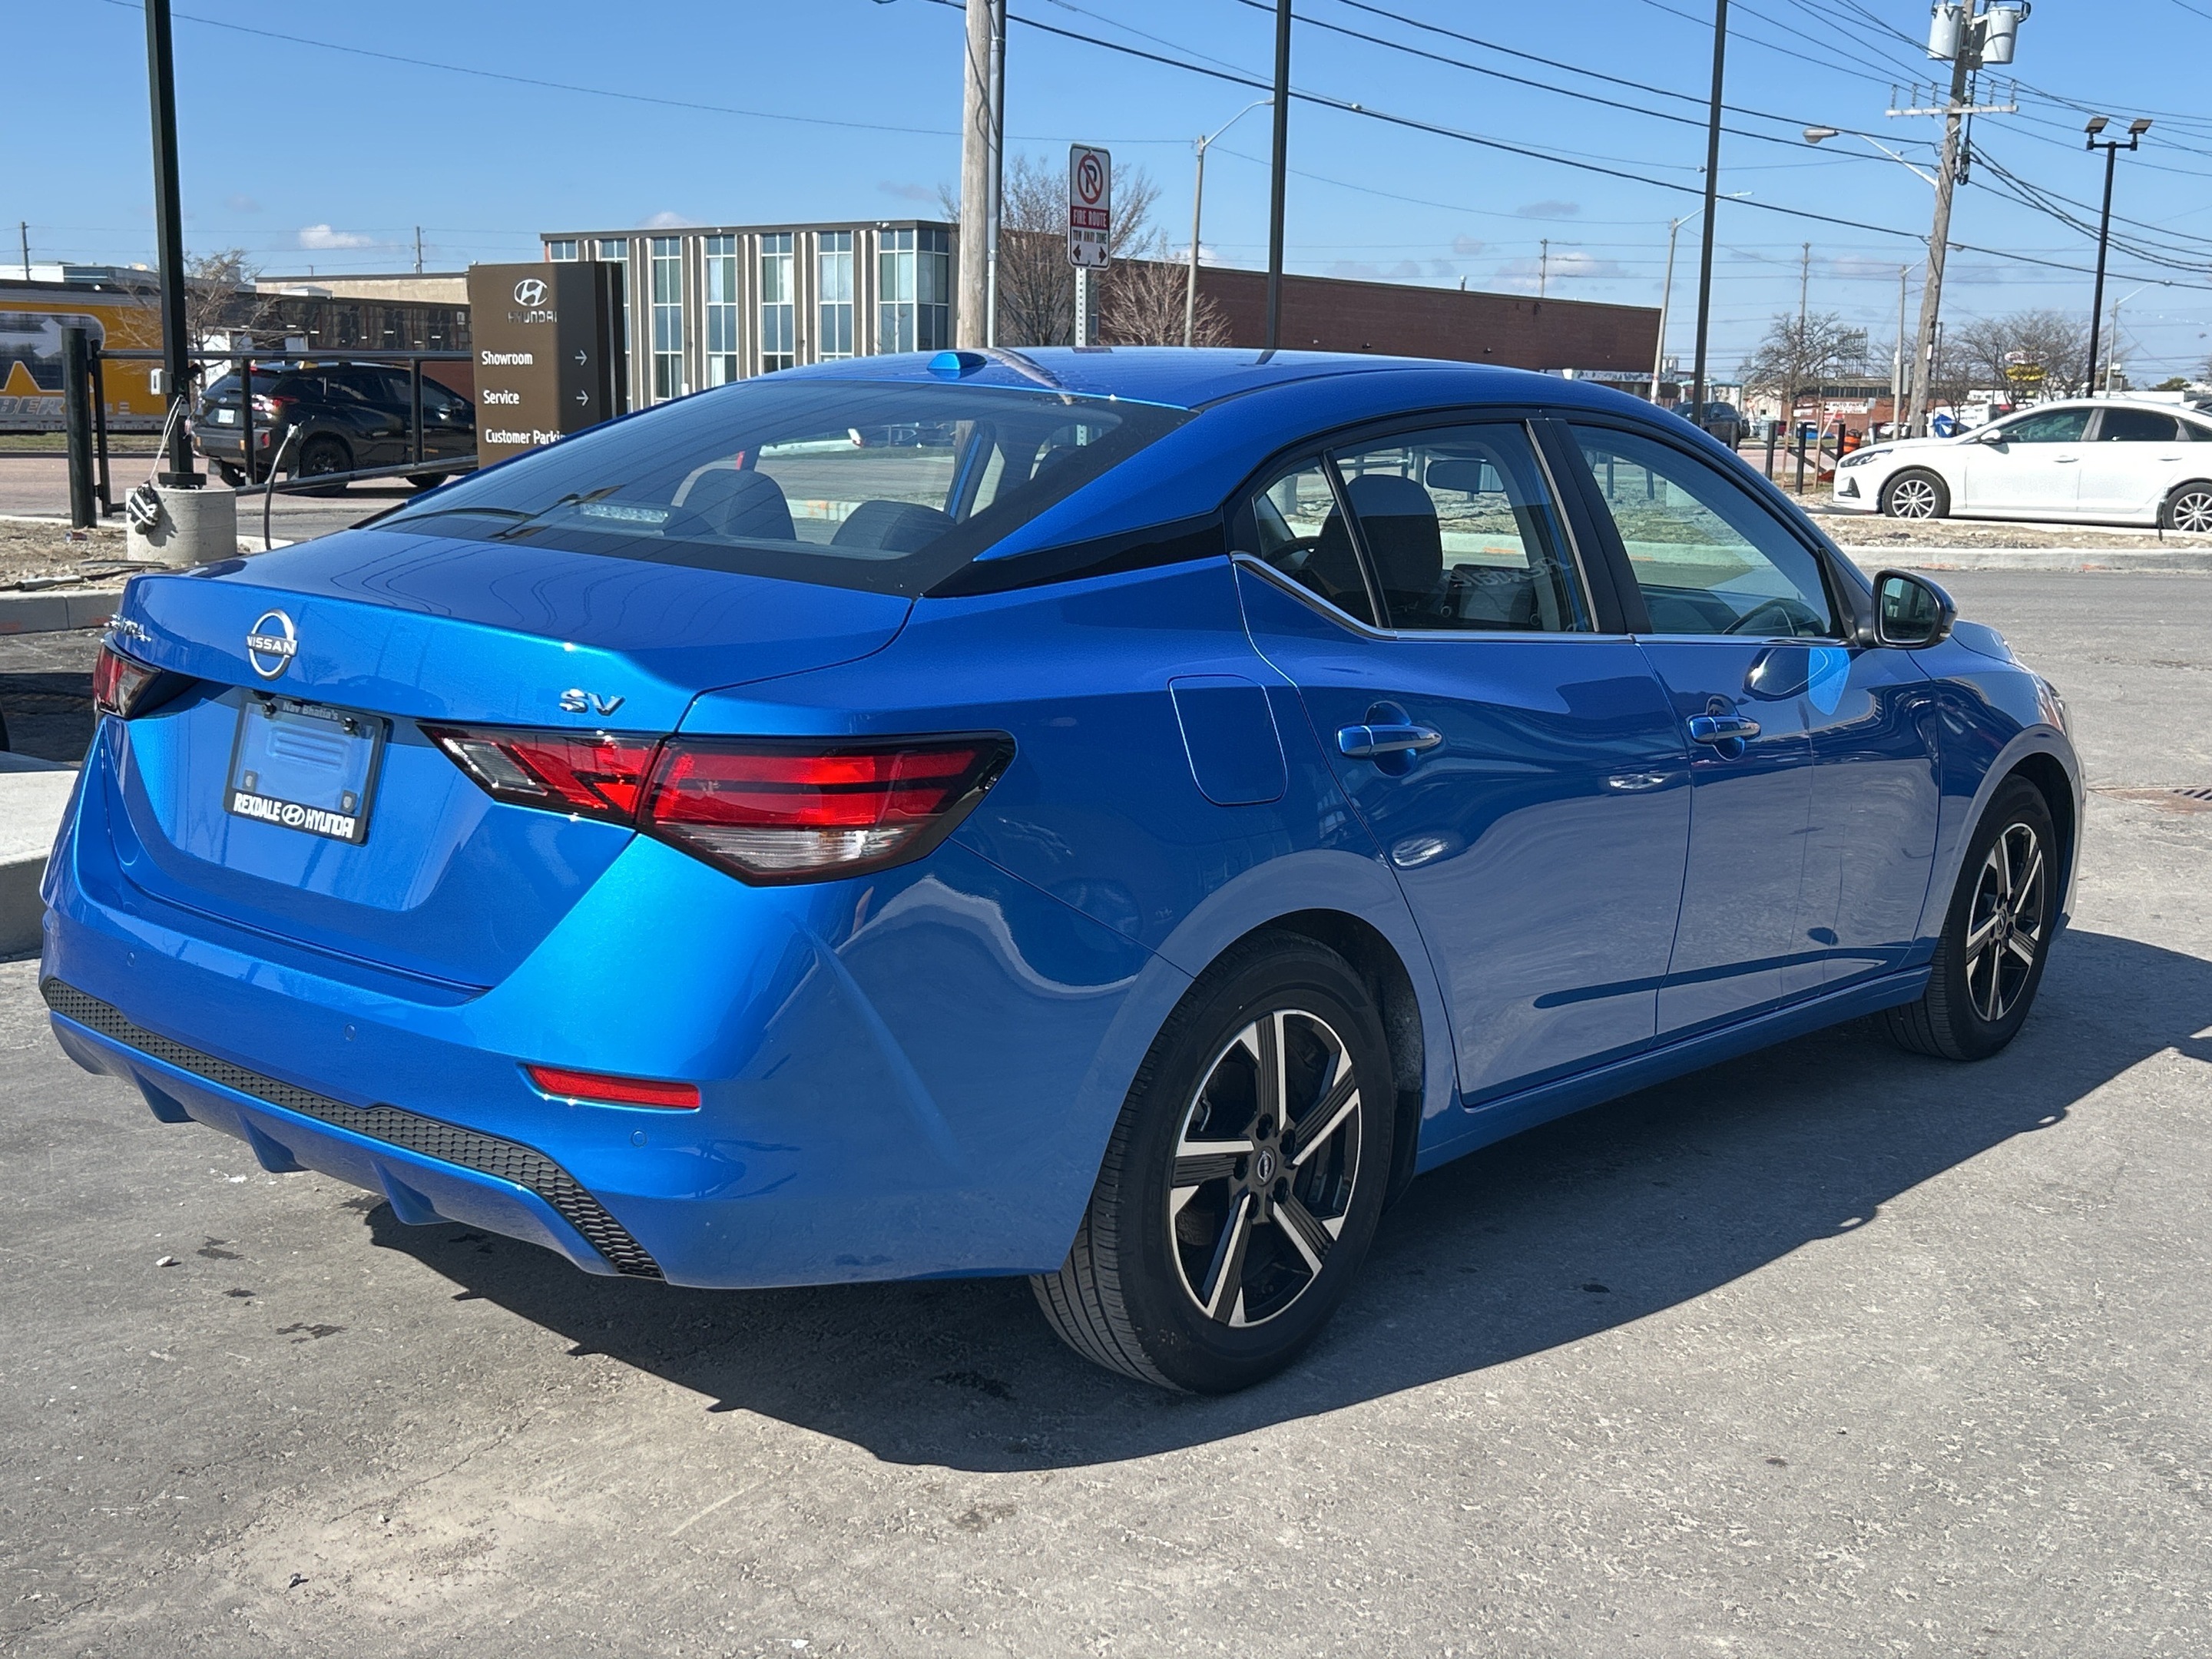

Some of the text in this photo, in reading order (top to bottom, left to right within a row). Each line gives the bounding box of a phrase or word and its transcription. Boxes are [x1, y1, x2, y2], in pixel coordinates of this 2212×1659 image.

[1073, 209, 1107, 228] FIRE ROUTE
[507, 310, 558, 323] HYUNDAI
[482, 350, 533, 366] Showroom
[483, 389, 520, 406] Service
[485, 429, 531, 445] Customer
[247, 635, 297, 655] NISSAN
[283, 700, 339, 721] Nav Bhatia's
[559, 687, 626, 717] SV
[233, 792, 356, 839] REXDALE HYUNDAI
